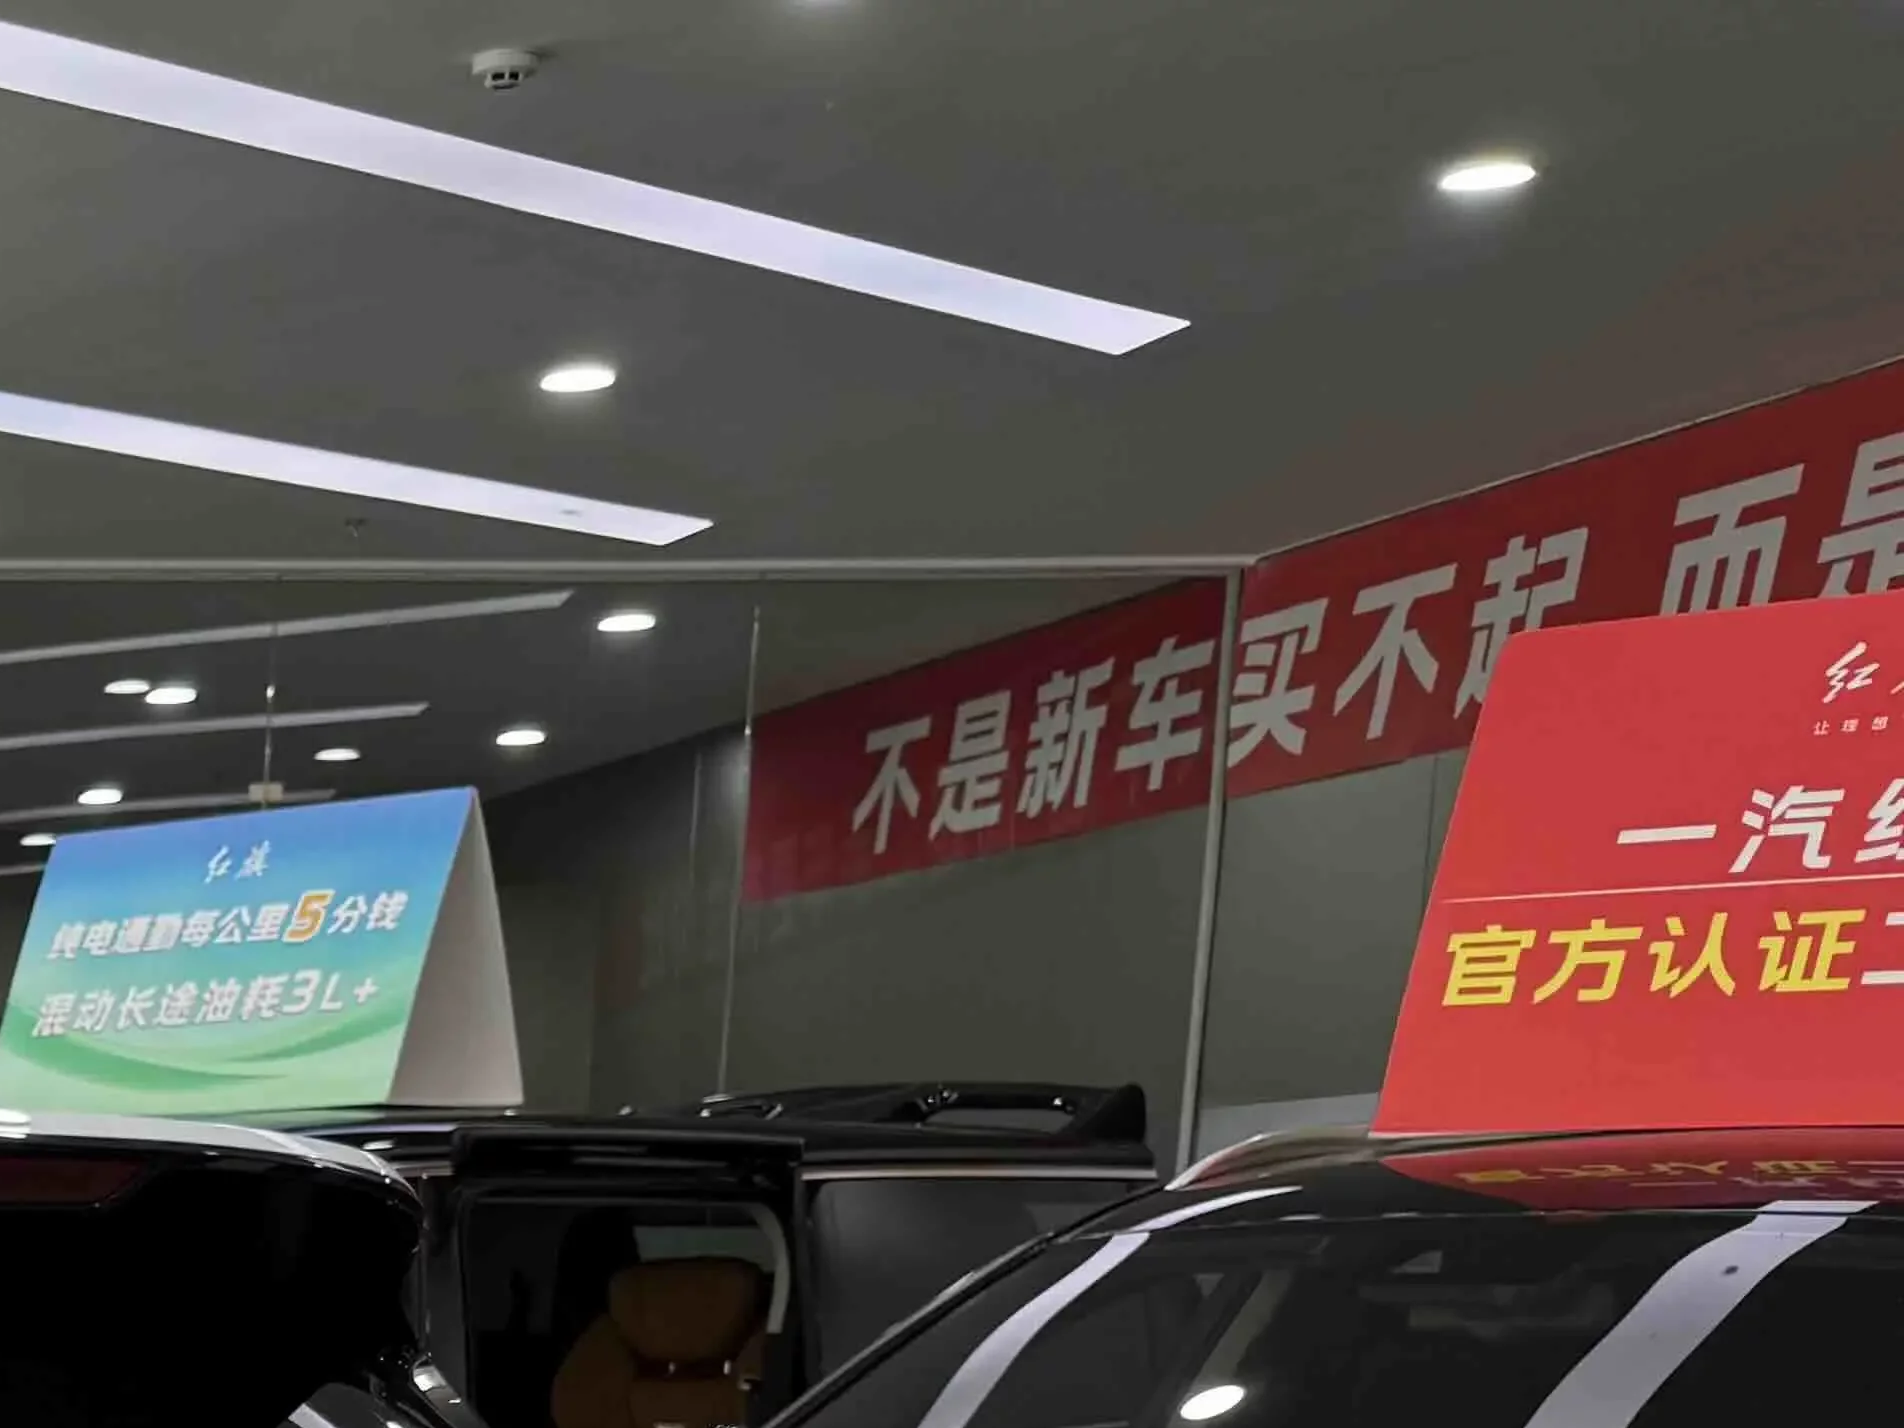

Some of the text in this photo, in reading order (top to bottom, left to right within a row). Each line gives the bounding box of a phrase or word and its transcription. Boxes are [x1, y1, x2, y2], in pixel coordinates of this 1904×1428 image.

[851, 525, 1590, 856] 不是新车买不起
[203, 839, 271, 884] 红旗
